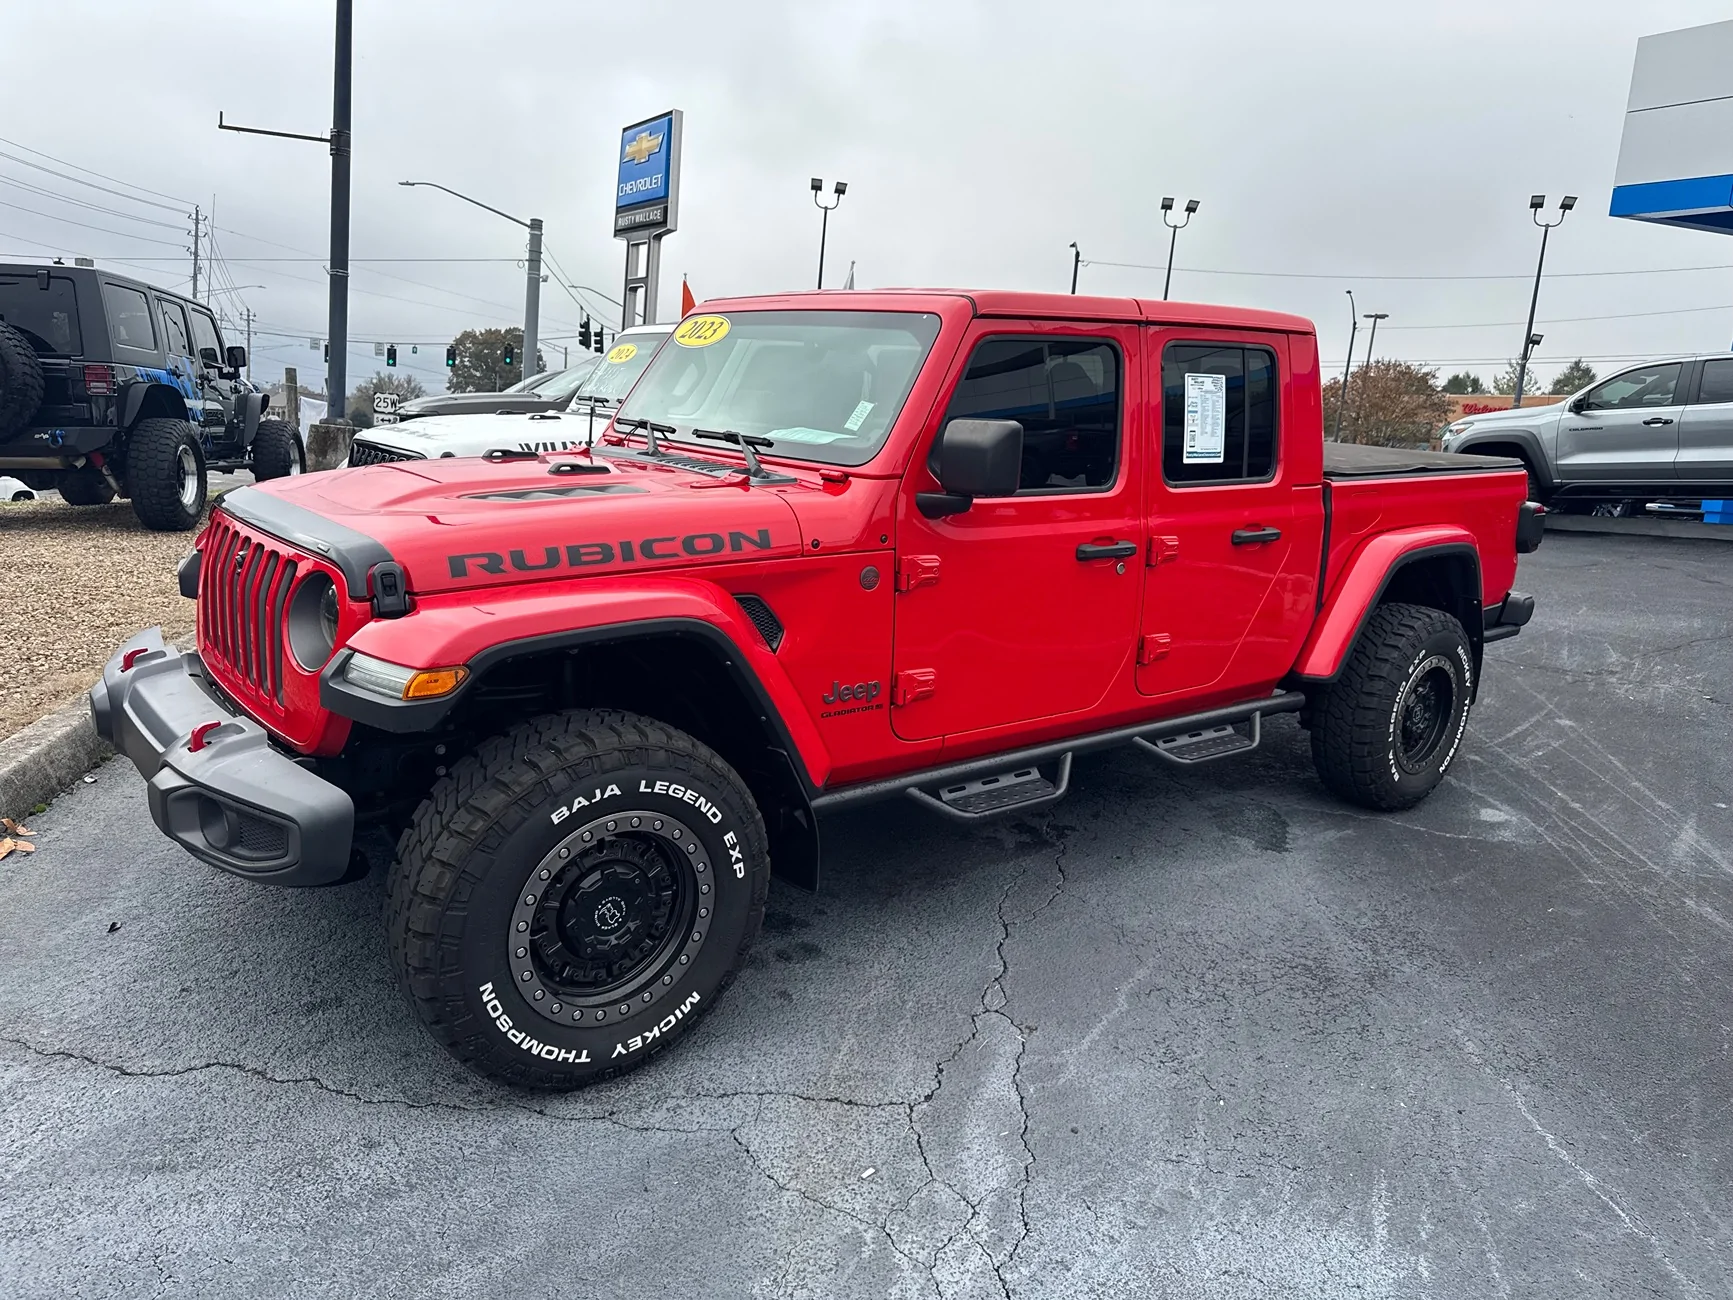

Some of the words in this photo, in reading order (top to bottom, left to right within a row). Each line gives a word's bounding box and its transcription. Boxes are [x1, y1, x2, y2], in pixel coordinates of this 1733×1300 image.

[619, 174, 662, 196] CHEVROLET
[618, 215, 634, 226] RUSTY
[635, 210, 661, 223] WALLACE
[678, 320, 725, 340] 2023
[375, 396, 398, 409] 25W
[447, 529, 772, 578] RUBICON
[1409, 649, 1425, 674] EXP
[1456, 645, 1471, 687] MICKEY
[823, 680, 881, 704] Jeep
[821, 704, 875, 719] GLADIATOR
[1388, 681, 1406, 742] LEGEND
[1439, 697, 1469, 773] THOMPSON
[1389, 749, 1400, 782] BAJA
[551, 784, 621, 824] BAJA
[639, 780, 722, 824] LEGEND
[724, 831, 744, 878] EXP
[480, 982, 590, 1062] THOMPSON
[611, 991, 700, 1058] MICKEY
